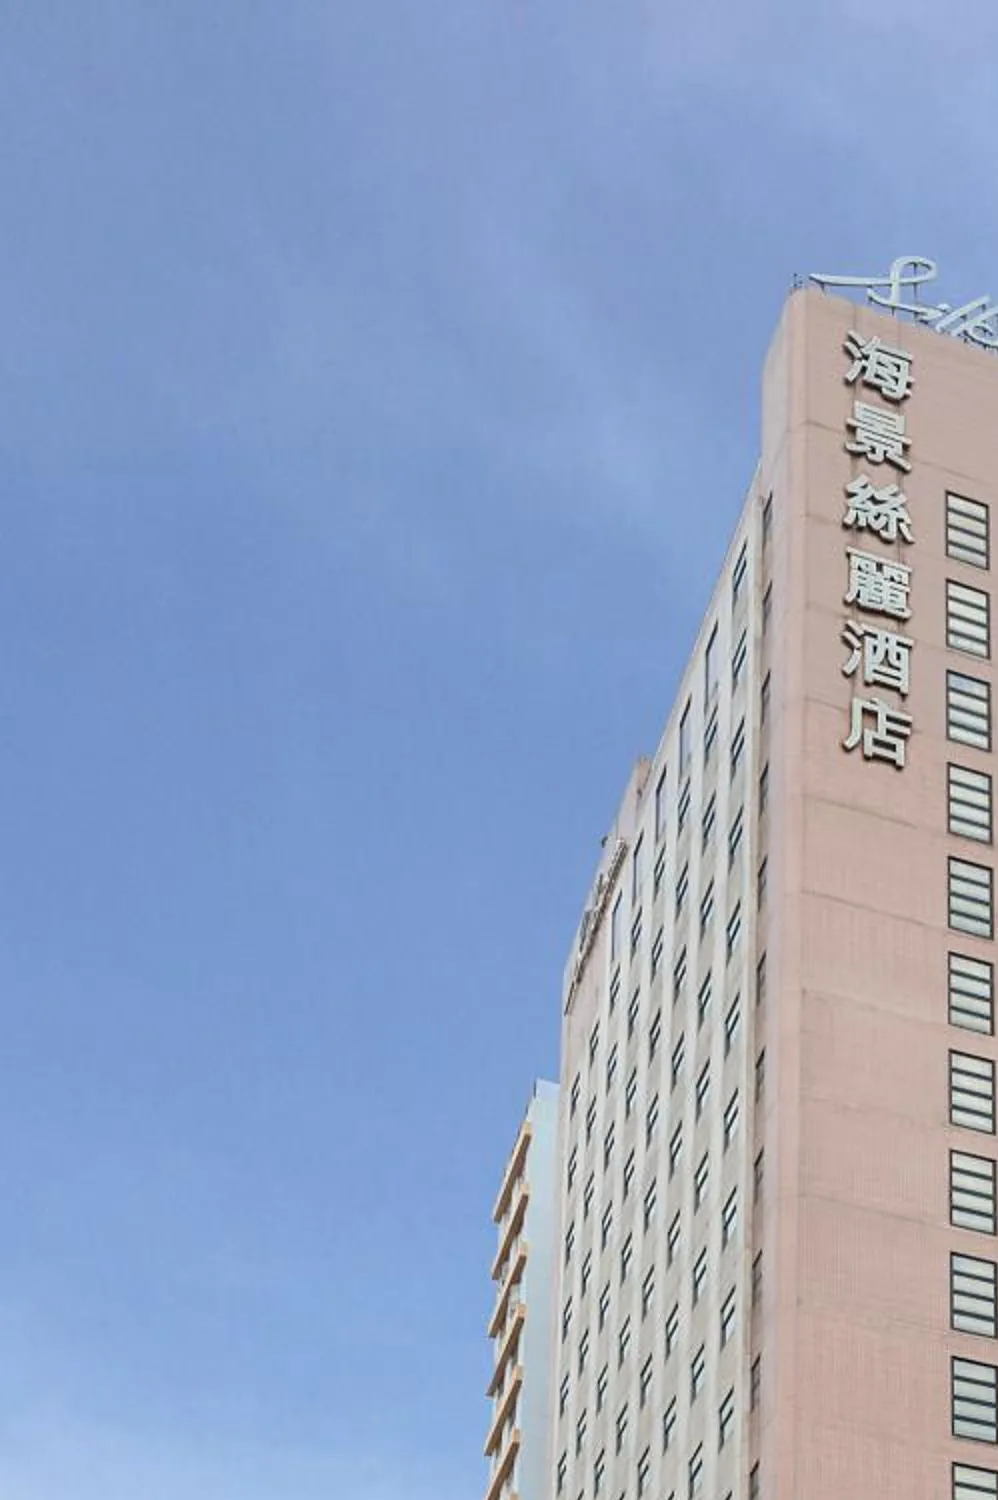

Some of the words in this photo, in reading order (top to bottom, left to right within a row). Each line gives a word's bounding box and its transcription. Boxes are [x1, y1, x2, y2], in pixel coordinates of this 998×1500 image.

[841, 329, 914, 769] 海景絲麗酒店
